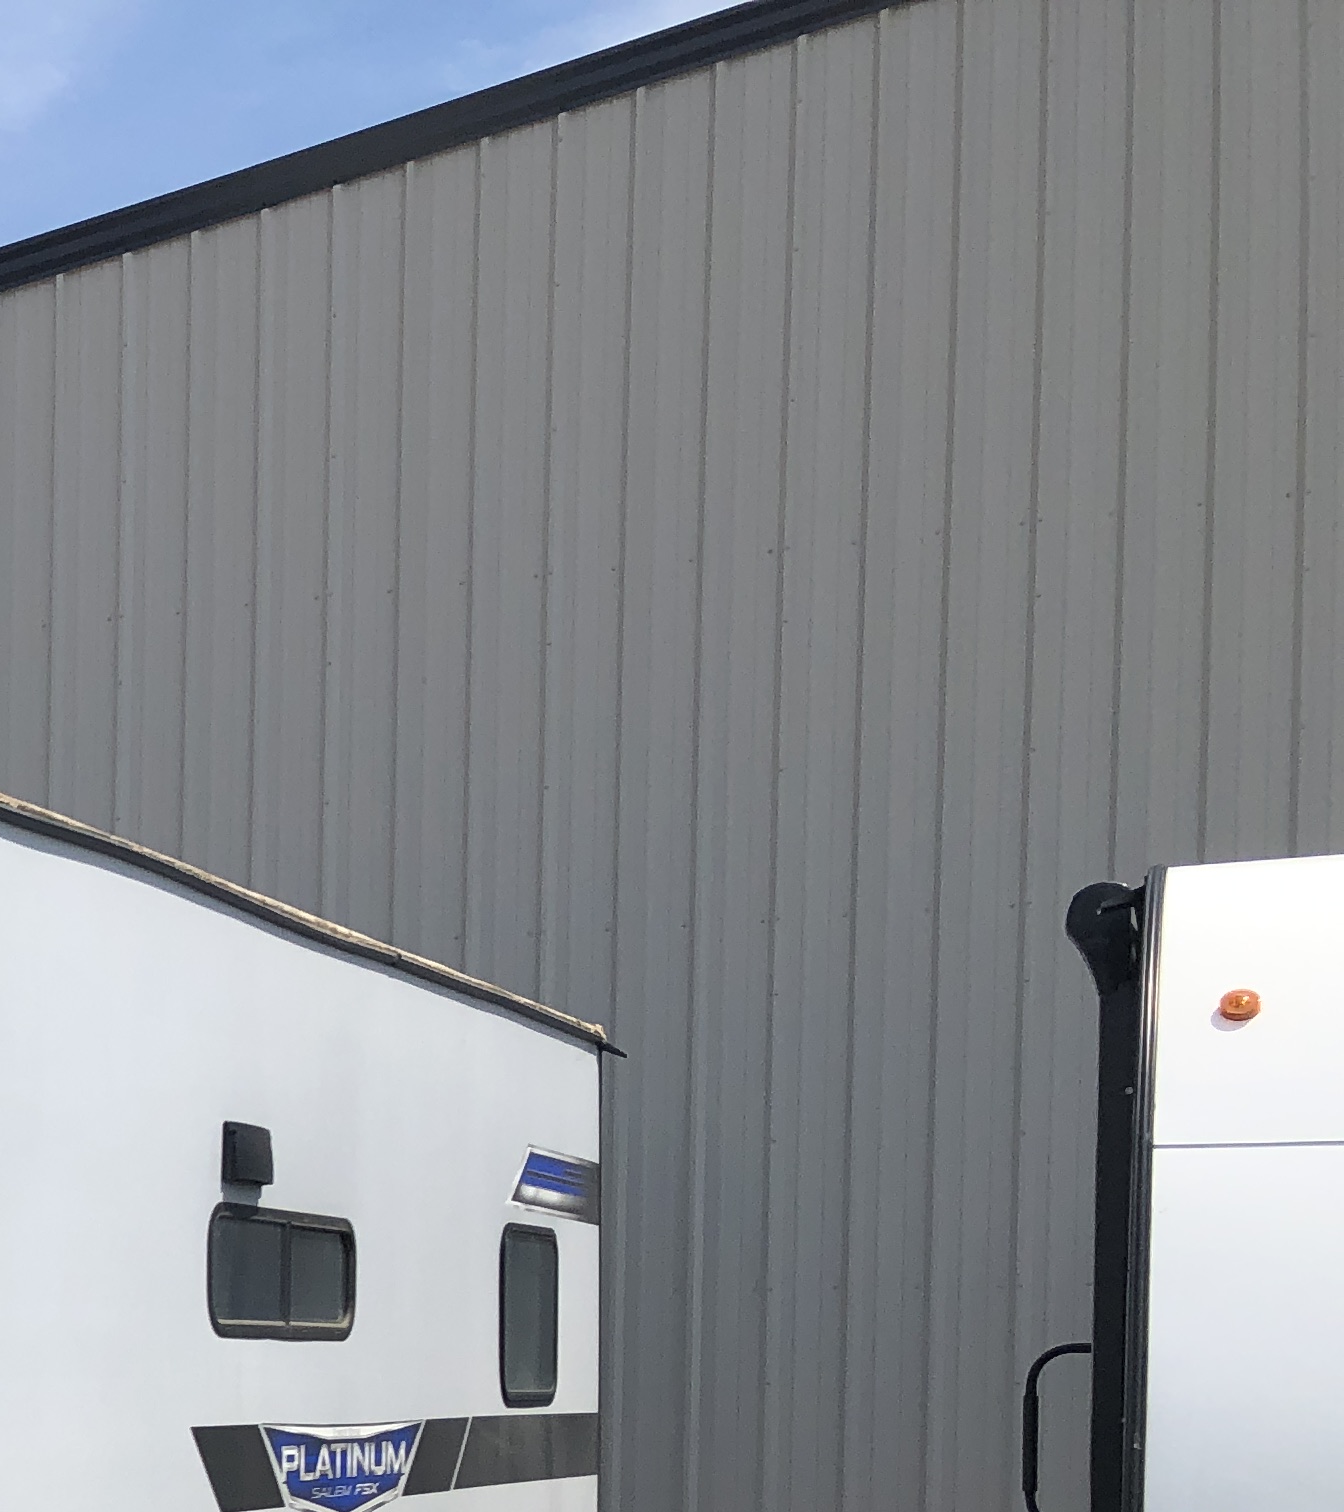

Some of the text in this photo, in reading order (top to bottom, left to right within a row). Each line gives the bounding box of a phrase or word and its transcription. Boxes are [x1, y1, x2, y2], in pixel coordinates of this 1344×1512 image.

[280, 1440, 407, 1484] PLATINUM
[312, 1482, 380, 1499] SALEM FSX
